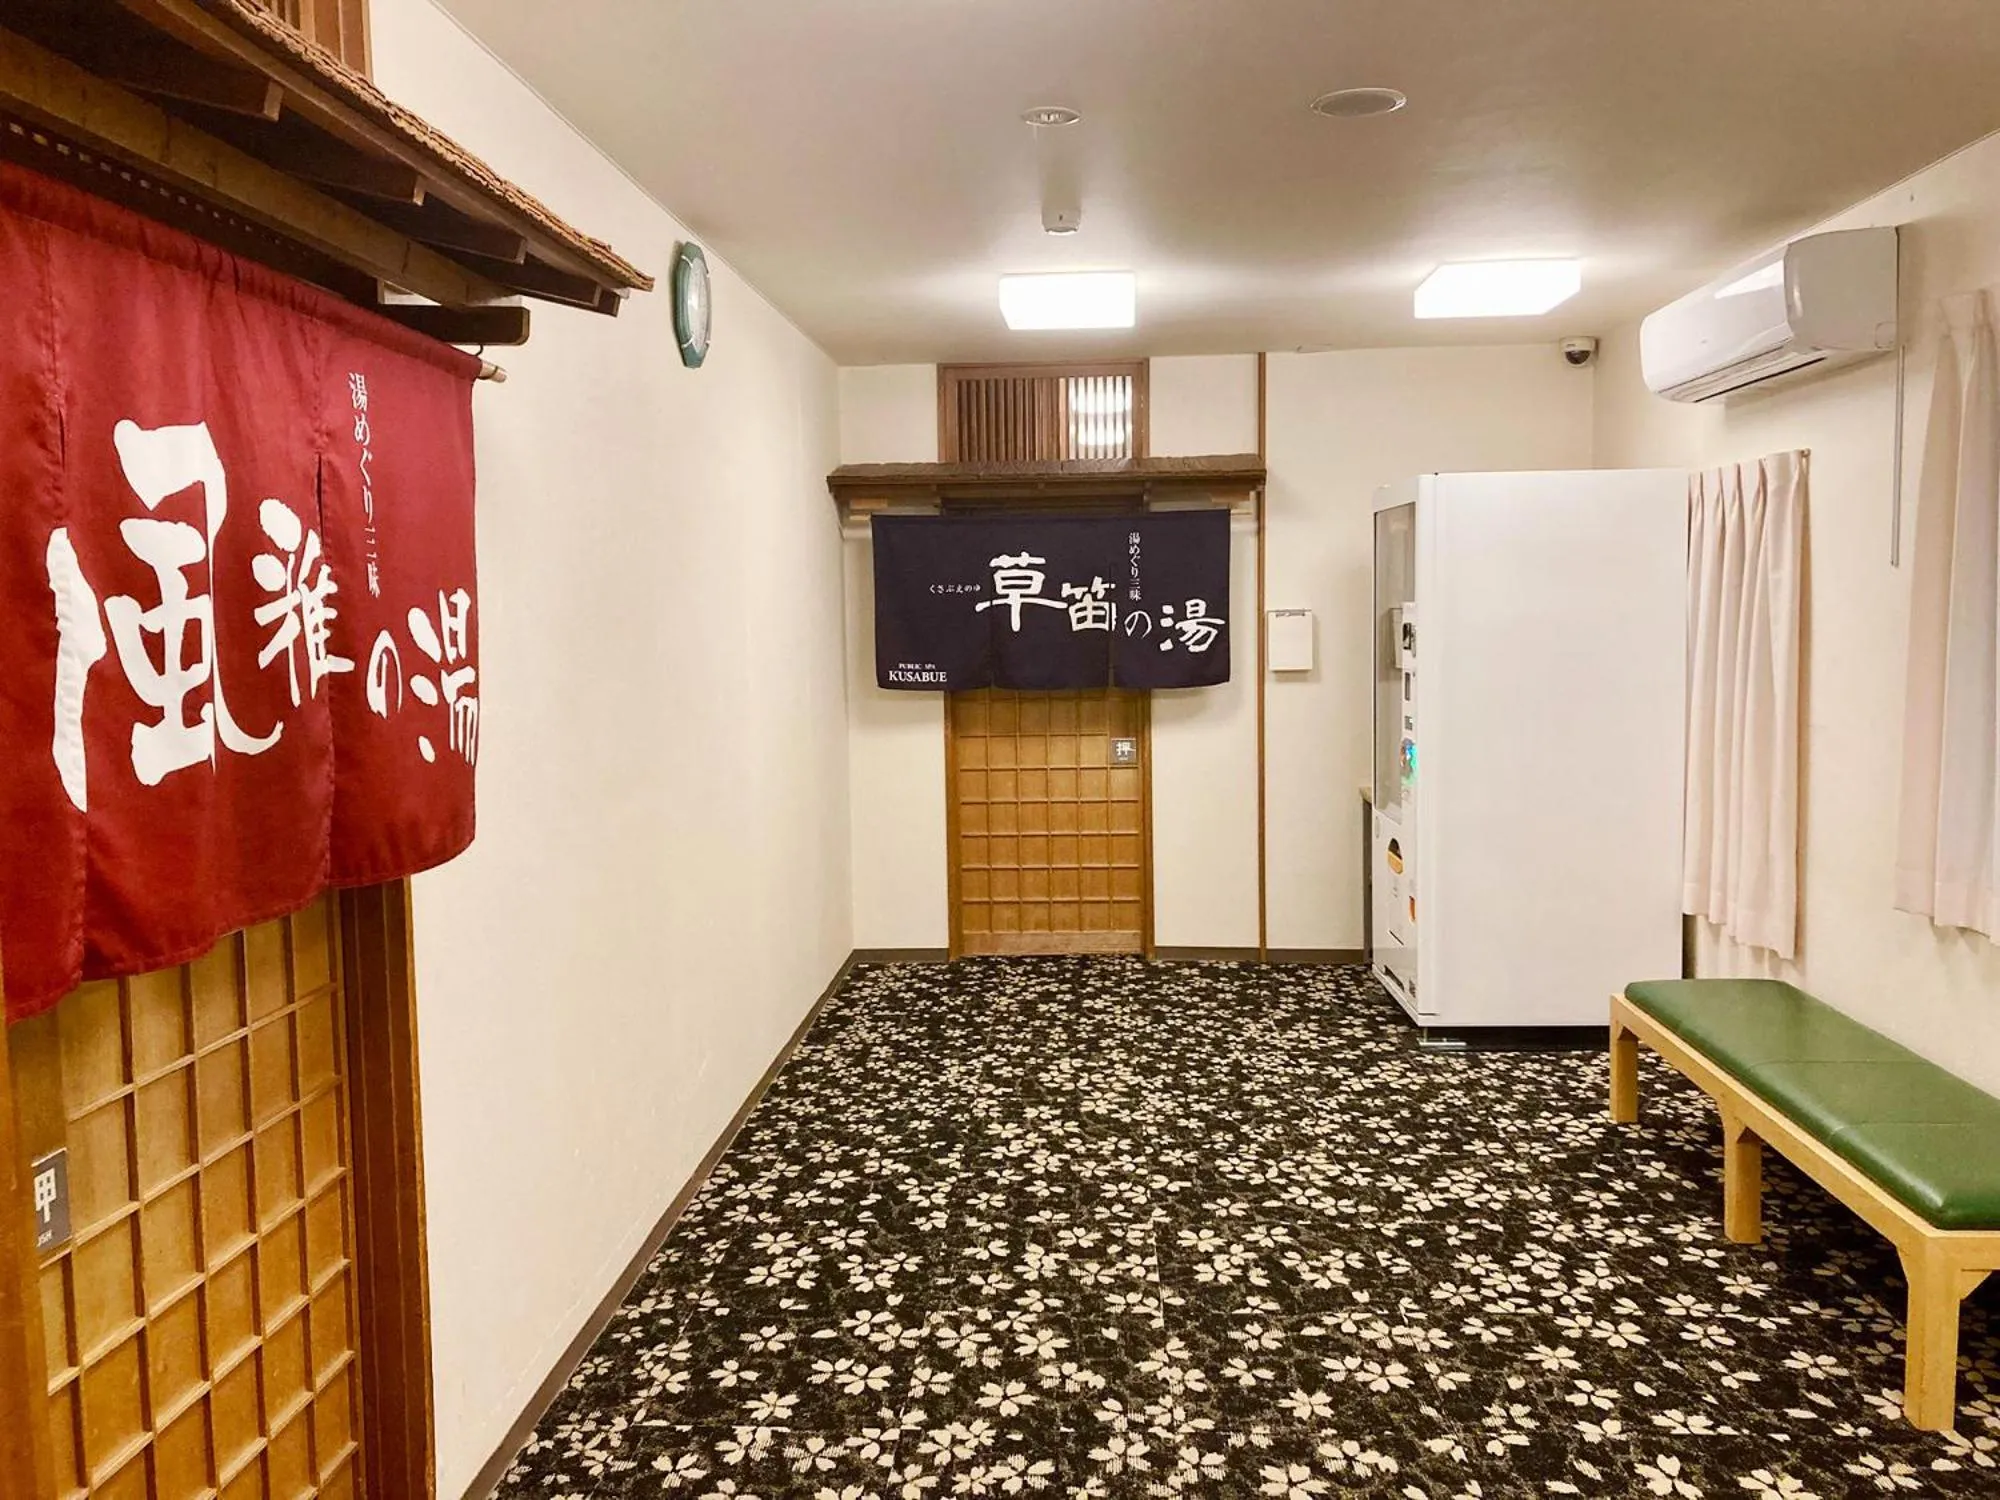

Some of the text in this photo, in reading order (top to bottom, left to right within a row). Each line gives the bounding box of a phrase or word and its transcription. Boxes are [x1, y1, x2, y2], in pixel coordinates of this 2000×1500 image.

[46, 418, 479, 813] 風雅の湯
[975, 552, 1225, 653] 草笛の湯
[888, 670, 948, 683] KUSABUE
